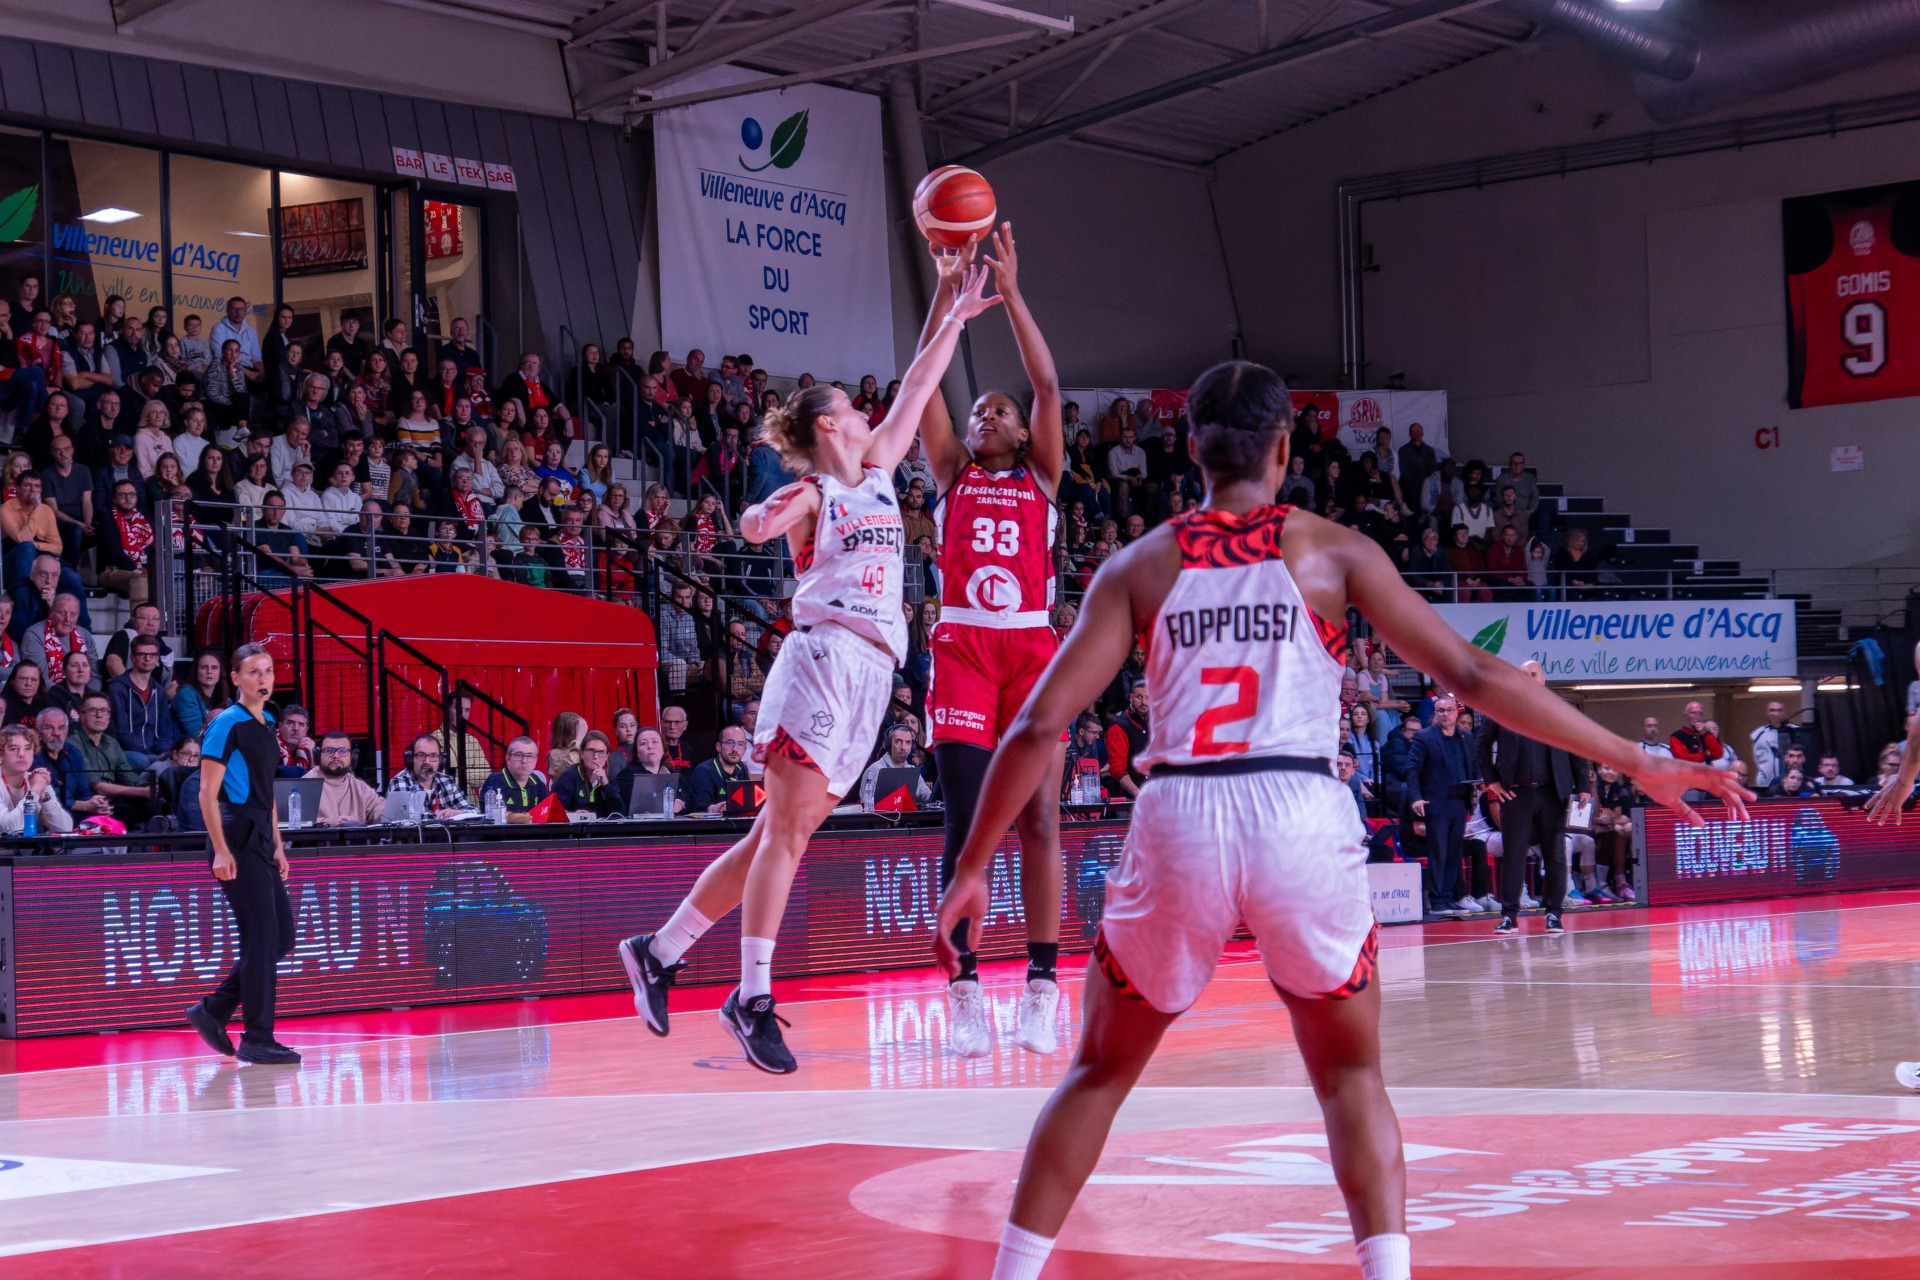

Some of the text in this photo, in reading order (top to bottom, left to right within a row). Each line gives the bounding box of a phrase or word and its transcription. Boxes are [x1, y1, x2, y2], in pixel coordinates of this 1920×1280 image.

[395, 154, 422, 170] BAR
[432, 161, 448, 174] LE
[457, 165, 482, 179] TEK
[701, 171, 846, 226] Villeneuve d'Ascq
[53, 222, 241, 278] Villeneuve d'Ascq
[726, 218, 822, 257] LA FORCE
[763, 265, 790, 293] DU
[1837, 271, 1891, 297] GOMIS
[138, 287, 161, 304] en
[748, 303, 809, 335] SPORT
[1840, 299, 1888, 378] 9
[1755, 427, 1780, 450] C1
[976, 497, 1018, 507] ZARAGOZA
[971, 517, 1020, 557] 33
[861, 565, 884, 595] 49
[1166, 604, 1299, 650] FOPPOSSI
[1527, 607, 1782, 643] Villeneuve d'Ascq
[1582, 652, 1619, 674] ville
[1625, 658, 1651, 673] en
[1655, 651, 1772, 673] mouvement
[948, 708, 986, 721] Zaragoza
[1191, 665, 1260, 758] 2
